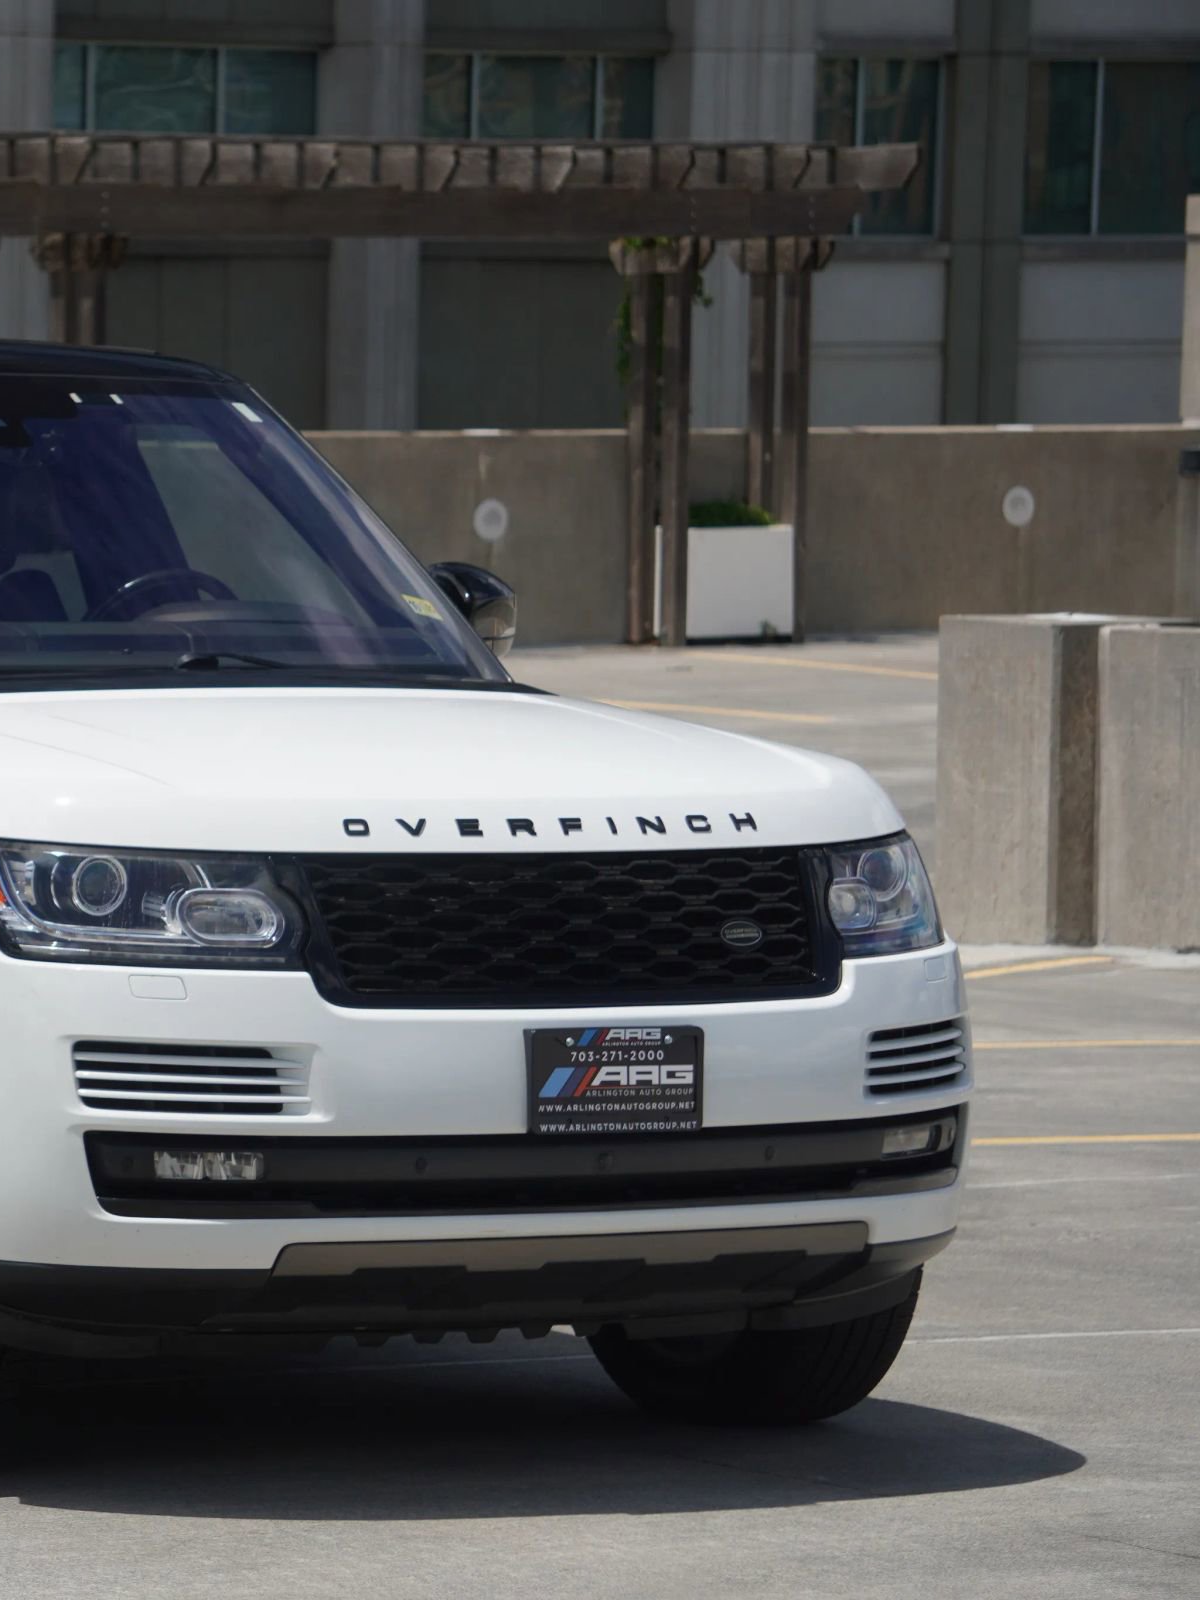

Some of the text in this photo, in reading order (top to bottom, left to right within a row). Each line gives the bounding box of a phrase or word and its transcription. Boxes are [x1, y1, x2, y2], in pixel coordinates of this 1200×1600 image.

[341, 811, 759, 838] OVERFINCH
[605, 1028, 662, 1040] AAG
[570, 1050, 665, 1062] 703-271-2000
[590, 1064, 694, 1086] AAG
[585, 1088, 694, 1097] ARLINGTON AUTO GROUP
[539, 1121, 698, 1133] WWW.ARLINGTONAUTOGROUP.NET
